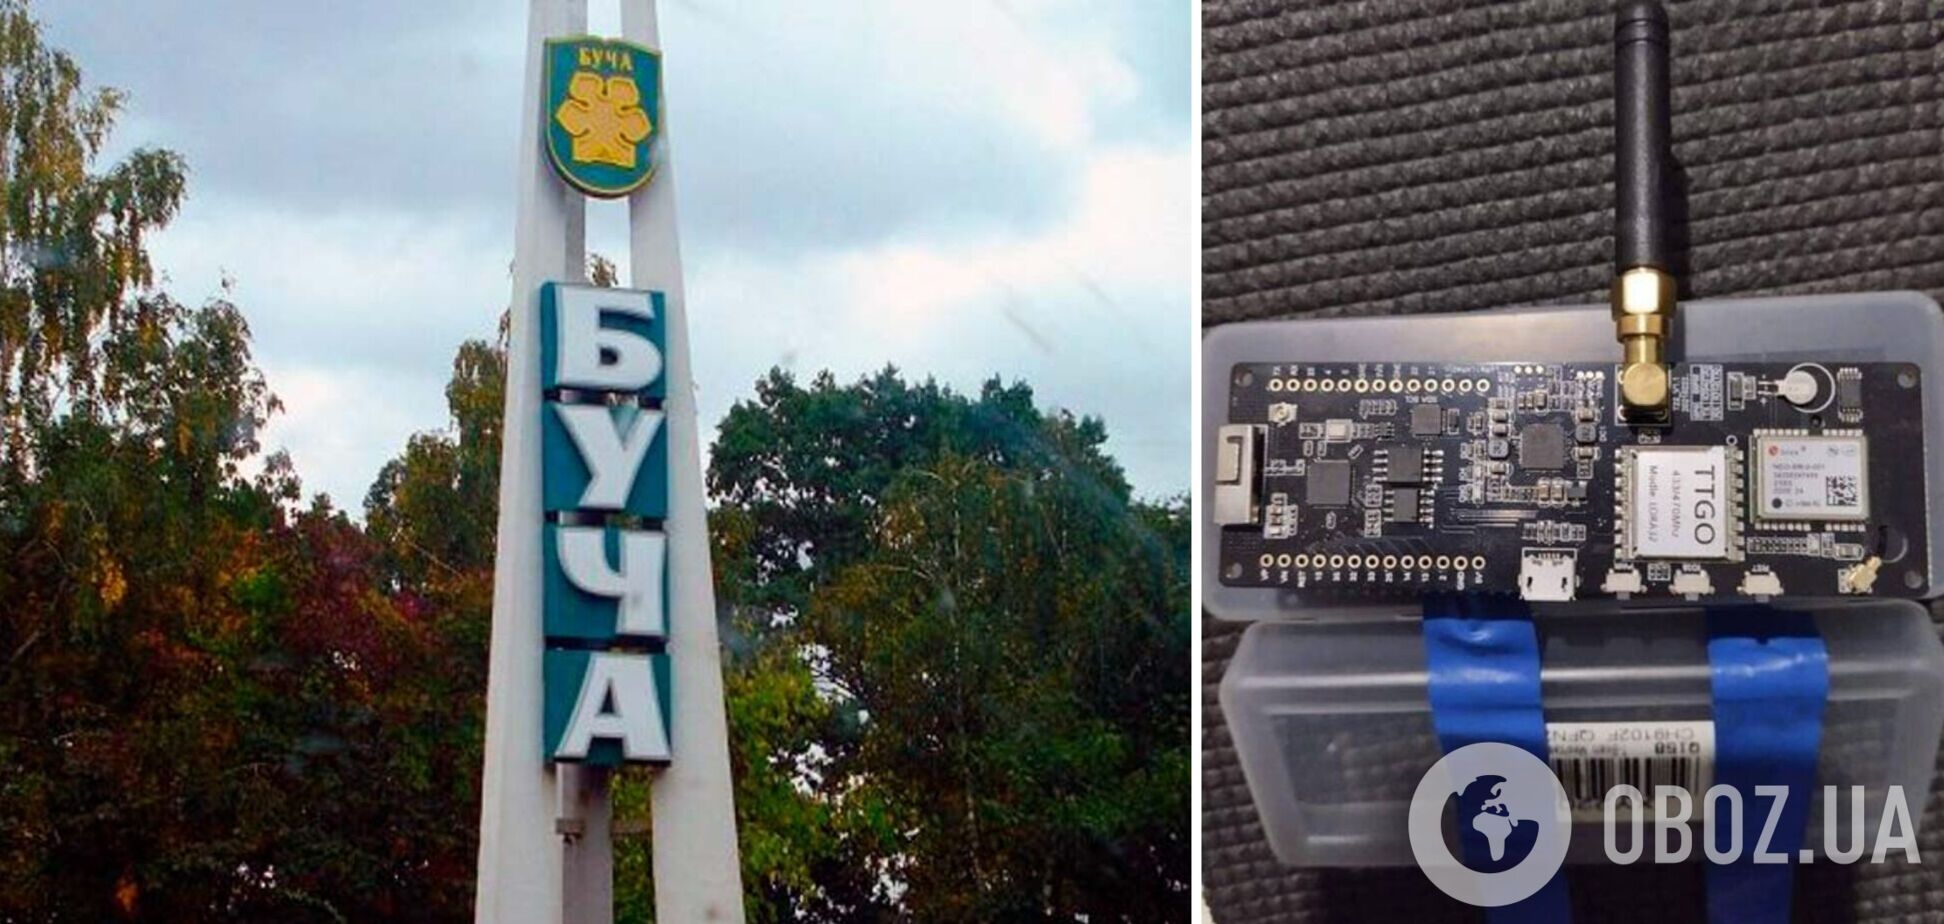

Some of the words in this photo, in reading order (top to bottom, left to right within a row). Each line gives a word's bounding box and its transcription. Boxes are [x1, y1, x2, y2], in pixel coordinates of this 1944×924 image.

[577, 47, 633, 71] БУЧА
[554, 285, 671, 760] БУЧА
[1694, 465, 1715, 544] TTGO
[1457, 571, 1465, 590] GND
